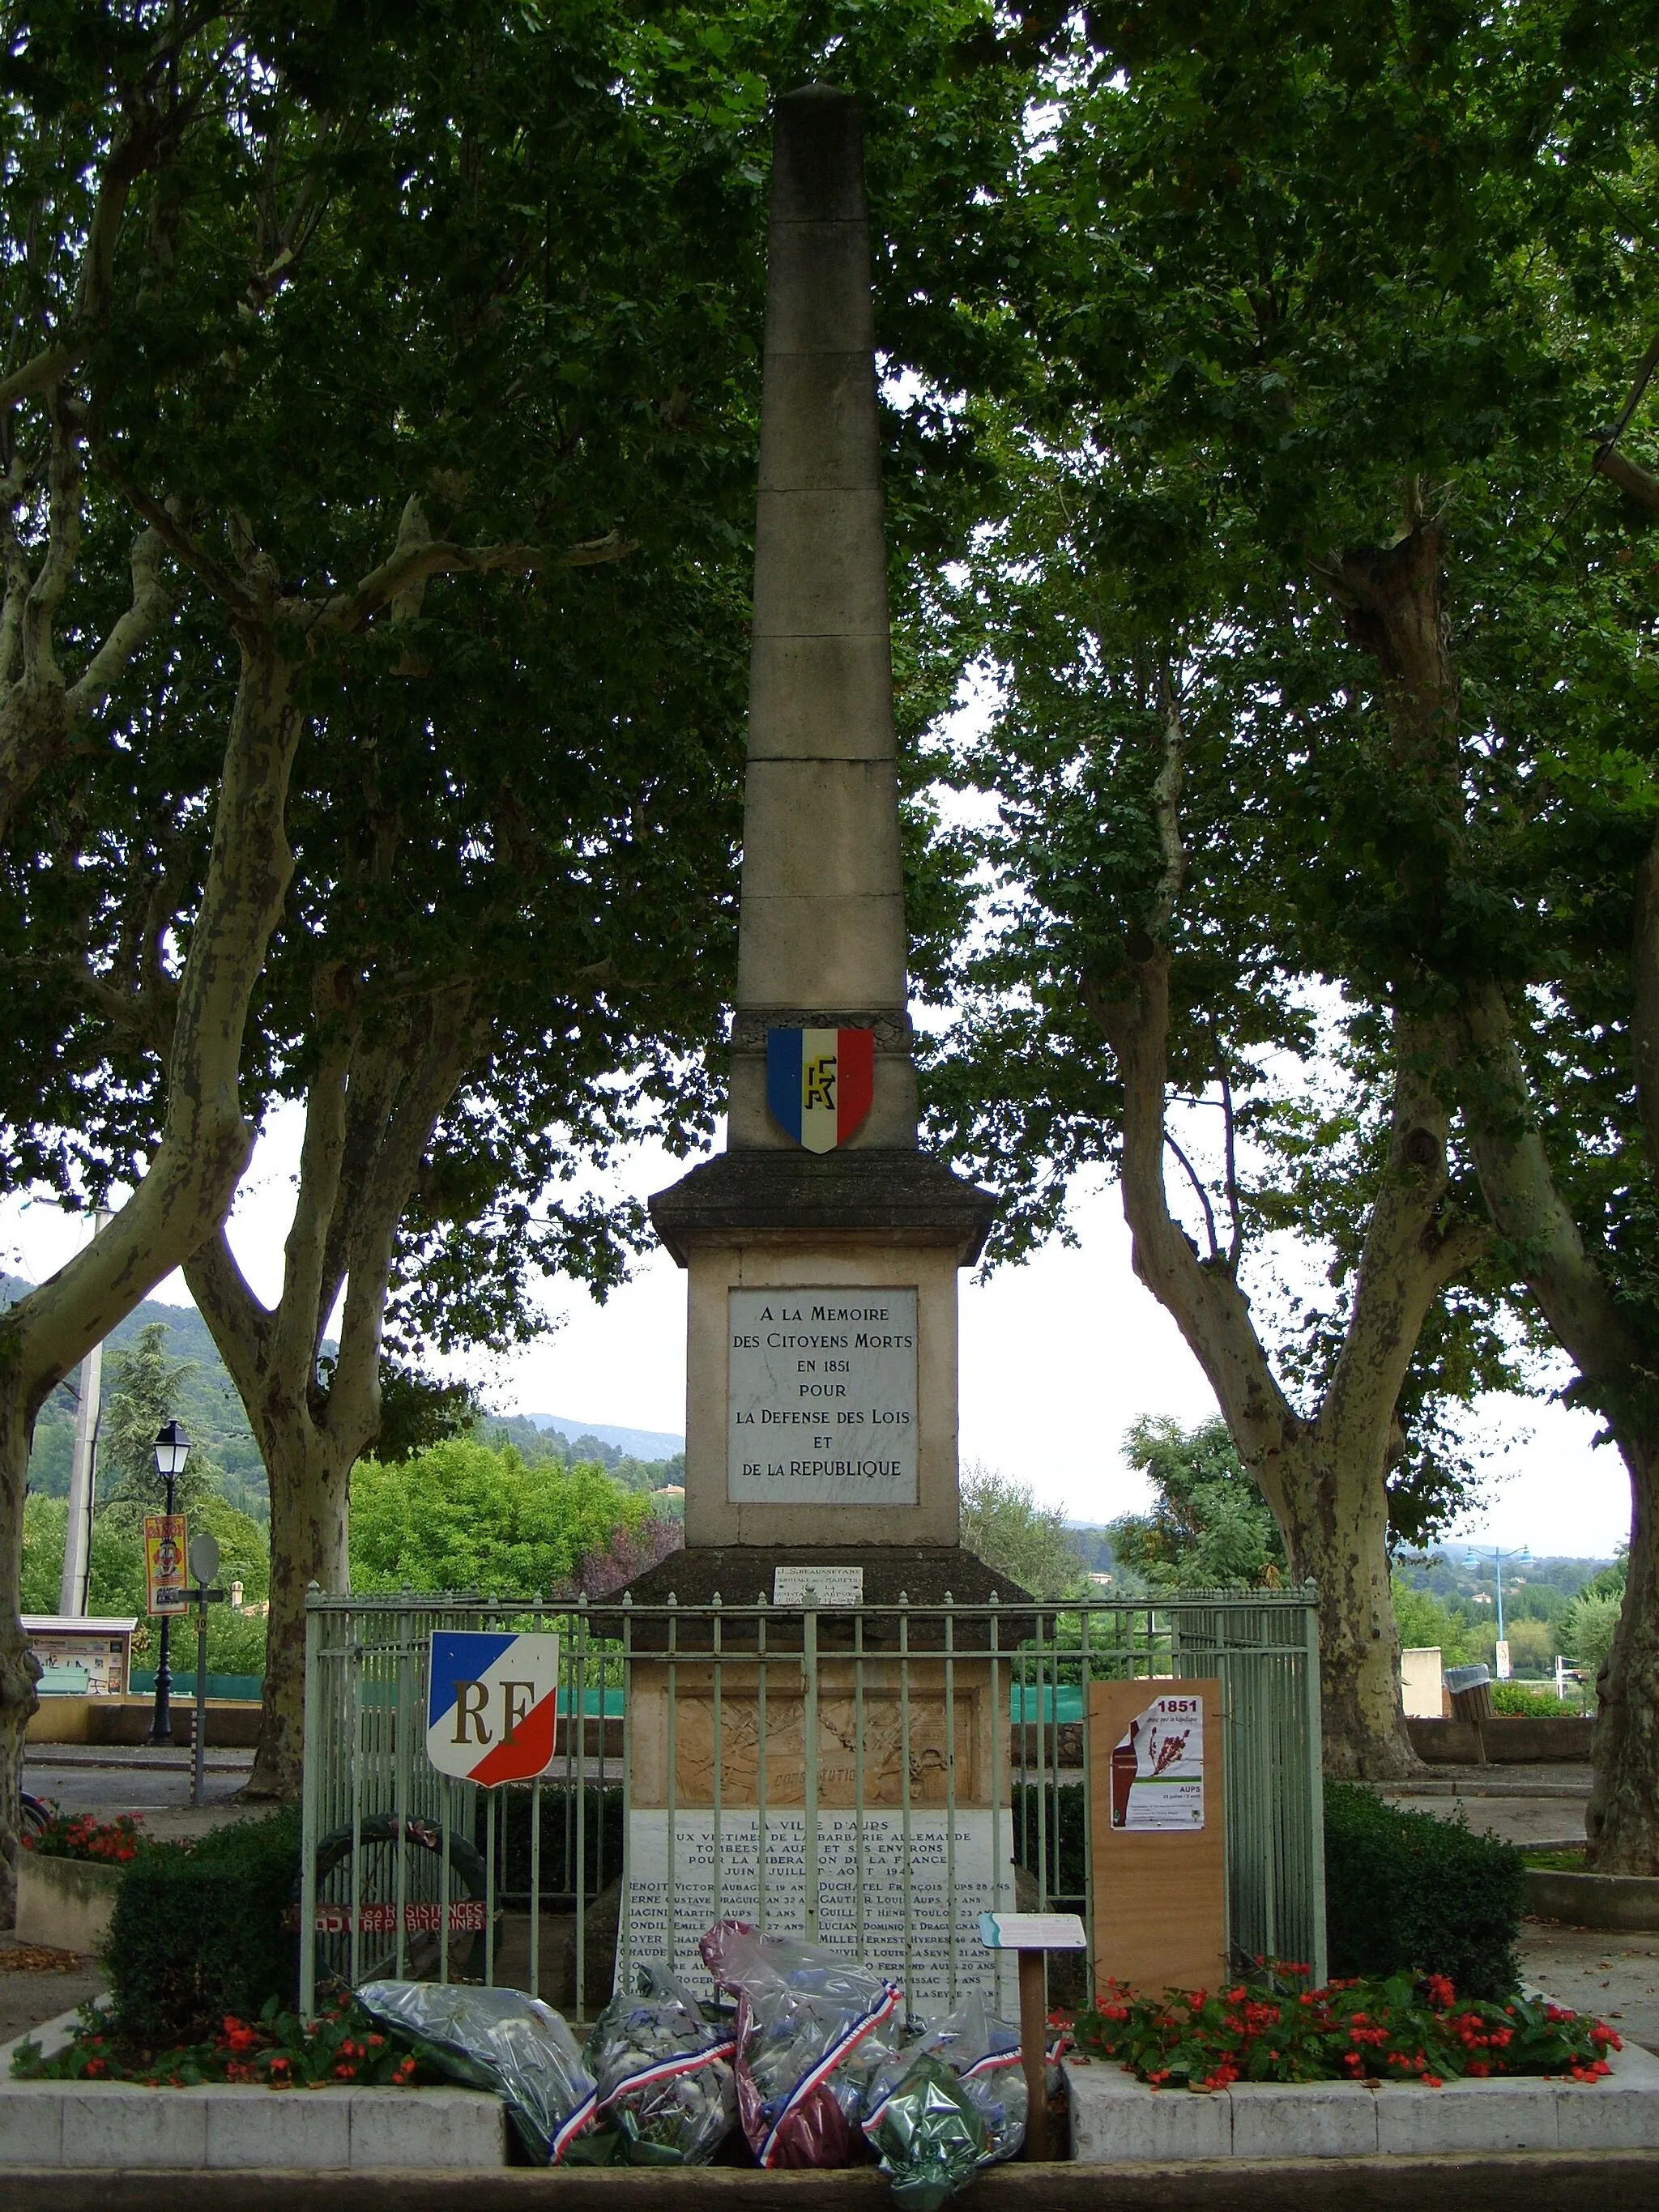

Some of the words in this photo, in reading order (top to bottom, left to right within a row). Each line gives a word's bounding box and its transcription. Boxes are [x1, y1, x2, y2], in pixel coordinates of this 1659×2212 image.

[760, 1306, 774, 1320] A
[783, 1309, 802, 1320] LA
[811, 1306, 889, 1320] MEMOIRE
[734, 1336, 760, 1348] DES
[767, 1333, 848, 1348] CITOYENS
[855, 1334, 912, 1348] MORTS
[798, 1361, 816, 1372] EN
[825, 1361, 850, 1372] 1851
[800, 1385, 846, 1396] POUR
[736, 1413, 754, 1423] LA
[761, 1409, 830, 1424] DEFENSE
[838, 1412, 864, 1423] DES
[872, 1409, 910, 1424] LOIS
[814, 1437, 832, 1448] ET
[743, 1464, 761, 1476] DE
[768, 1464, 783, 1476] LA
[791, 1461, 901, 1477] REPUBLIQUE
[196, 1619, 206, 1628] 10
[1158, 1700, 1196, 1712] 1851
[450, 1680, 534, 1745] RF
[774, 1769, 864, 1787] CONSITUTIO
[780, 1822, 823, 1830] VILE
[889, 1883, 942, 1892] FRNÇOIS
[820, 1895, 872, 1903] GAUTIR
[386, 1903, 483, 1919] RSISTNCES
[821, 1908, 872, 1916] GUILLT
[364, 1918, 481, 1932] REPBLICINES
[864, 1922, 916, 1930] DOMINIQE
[867, 1935, 905, 1943] ERNEST
[911, 1935, 949, 1943] HYERES
[955, 1935, 966, 1943] 46
[970, 1935, 982, 1943] AN
[873, 1949, 904, 1957] LOUIS
[924, 1949, 952, 1957] SEYN
[958, 1949, 969, 1957] 21
[971, 1949, 990, 1957] ANS
